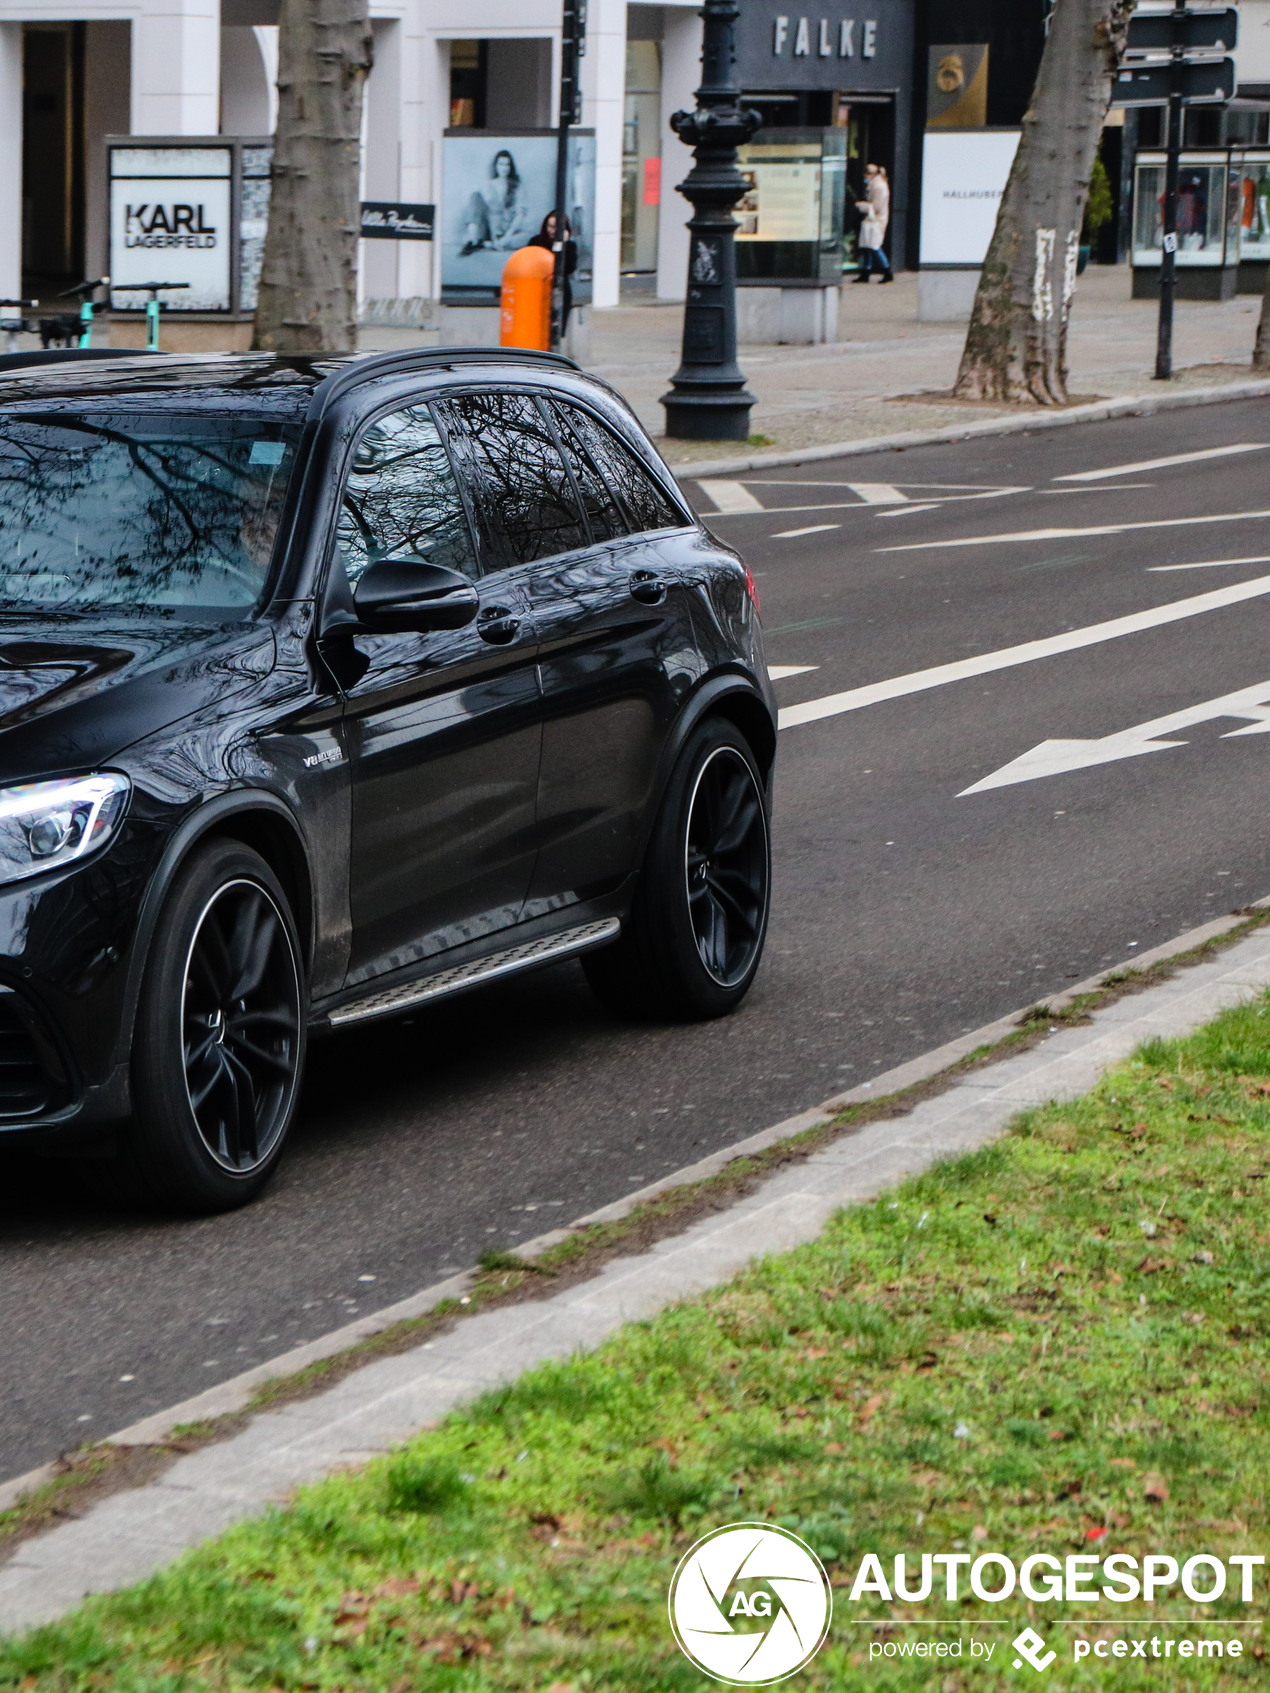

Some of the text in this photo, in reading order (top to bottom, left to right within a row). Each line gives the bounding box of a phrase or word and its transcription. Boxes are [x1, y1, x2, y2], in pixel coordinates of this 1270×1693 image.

[774, 15, 877, 58] FALKE
[125, 203, 216, 234] KARL
[125, 235, 217, 249] LAGERFELD
